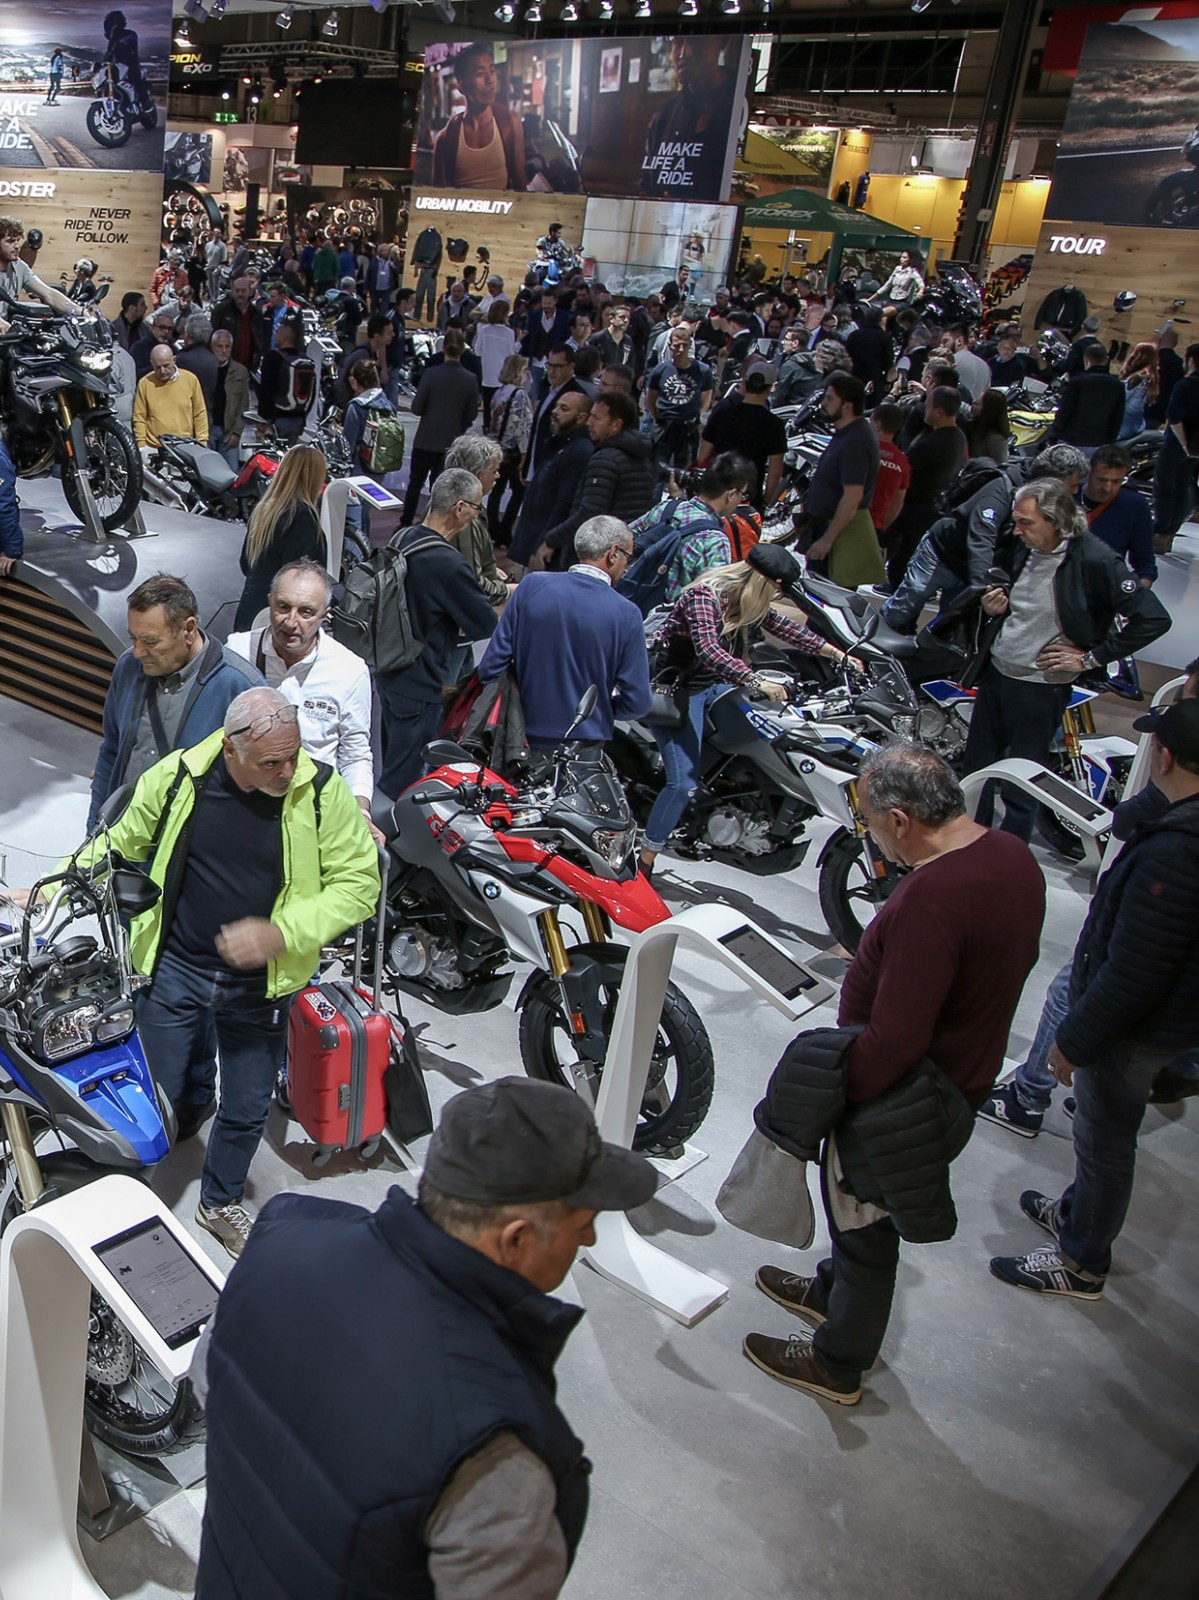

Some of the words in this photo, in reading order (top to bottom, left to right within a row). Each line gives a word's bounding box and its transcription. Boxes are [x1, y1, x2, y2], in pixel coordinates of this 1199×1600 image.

[246, 106, 257, 124] 13
[5, 116, 20, 132] A
[658, 142, 704, 157] MAKE
[641, 156, 674, 170] LIFE
[673, 157, 685, 171] A
[657, 171, 694, 186] RIDE.
[89, 208, 131, 219] NEVER
[415, 197, 456, 211] URBAN
[456, 199, 513, 215] MOBILITY
[64, 219, 93, 230] RIDE
[97, 220, 113, 231] TO
[76, 232, 129, 244] FOLLOW.
[1050, 236, 1106, 255] TOUR
[674, 384, 686, 394] 73
